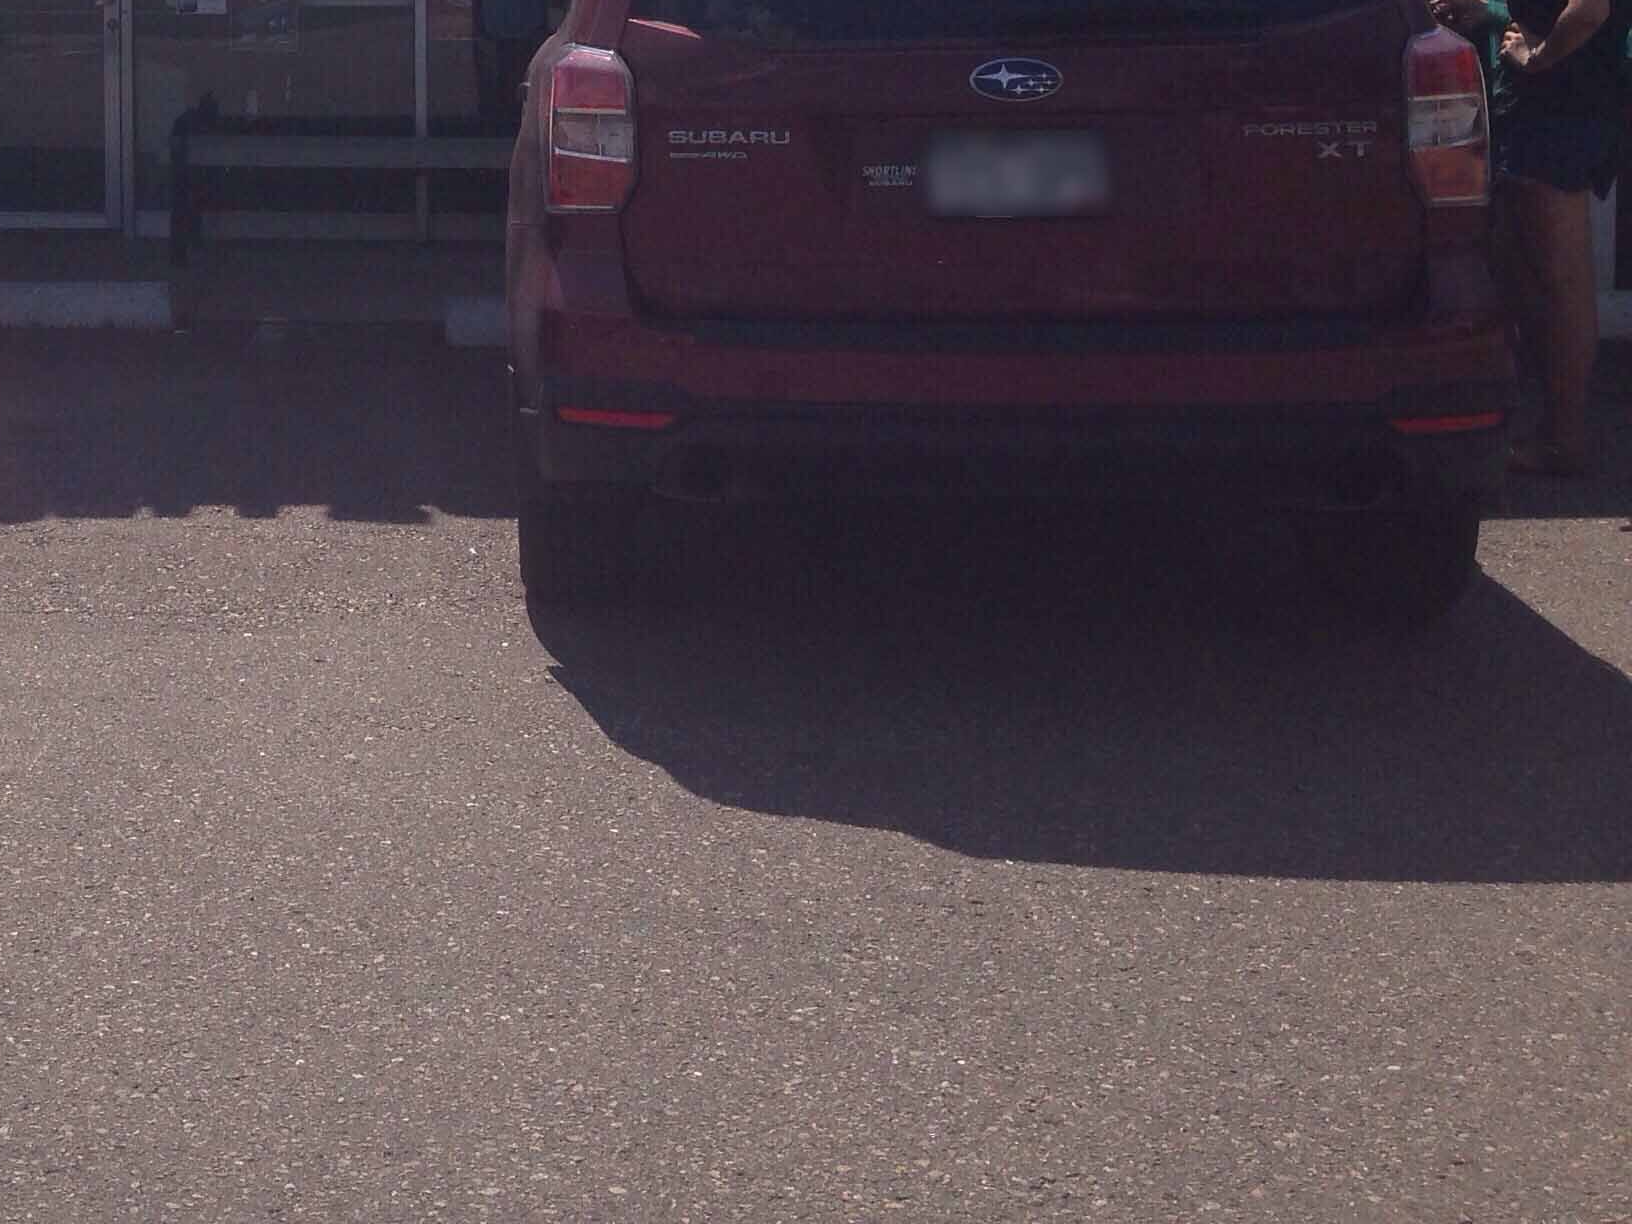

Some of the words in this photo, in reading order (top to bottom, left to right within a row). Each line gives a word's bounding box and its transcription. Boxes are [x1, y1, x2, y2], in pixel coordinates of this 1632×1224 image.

[667, 129, 791, 145] SUBARU
[1241, 120, 1377, 137] FORESTER
[1315, 138, 1372, 160] XT
